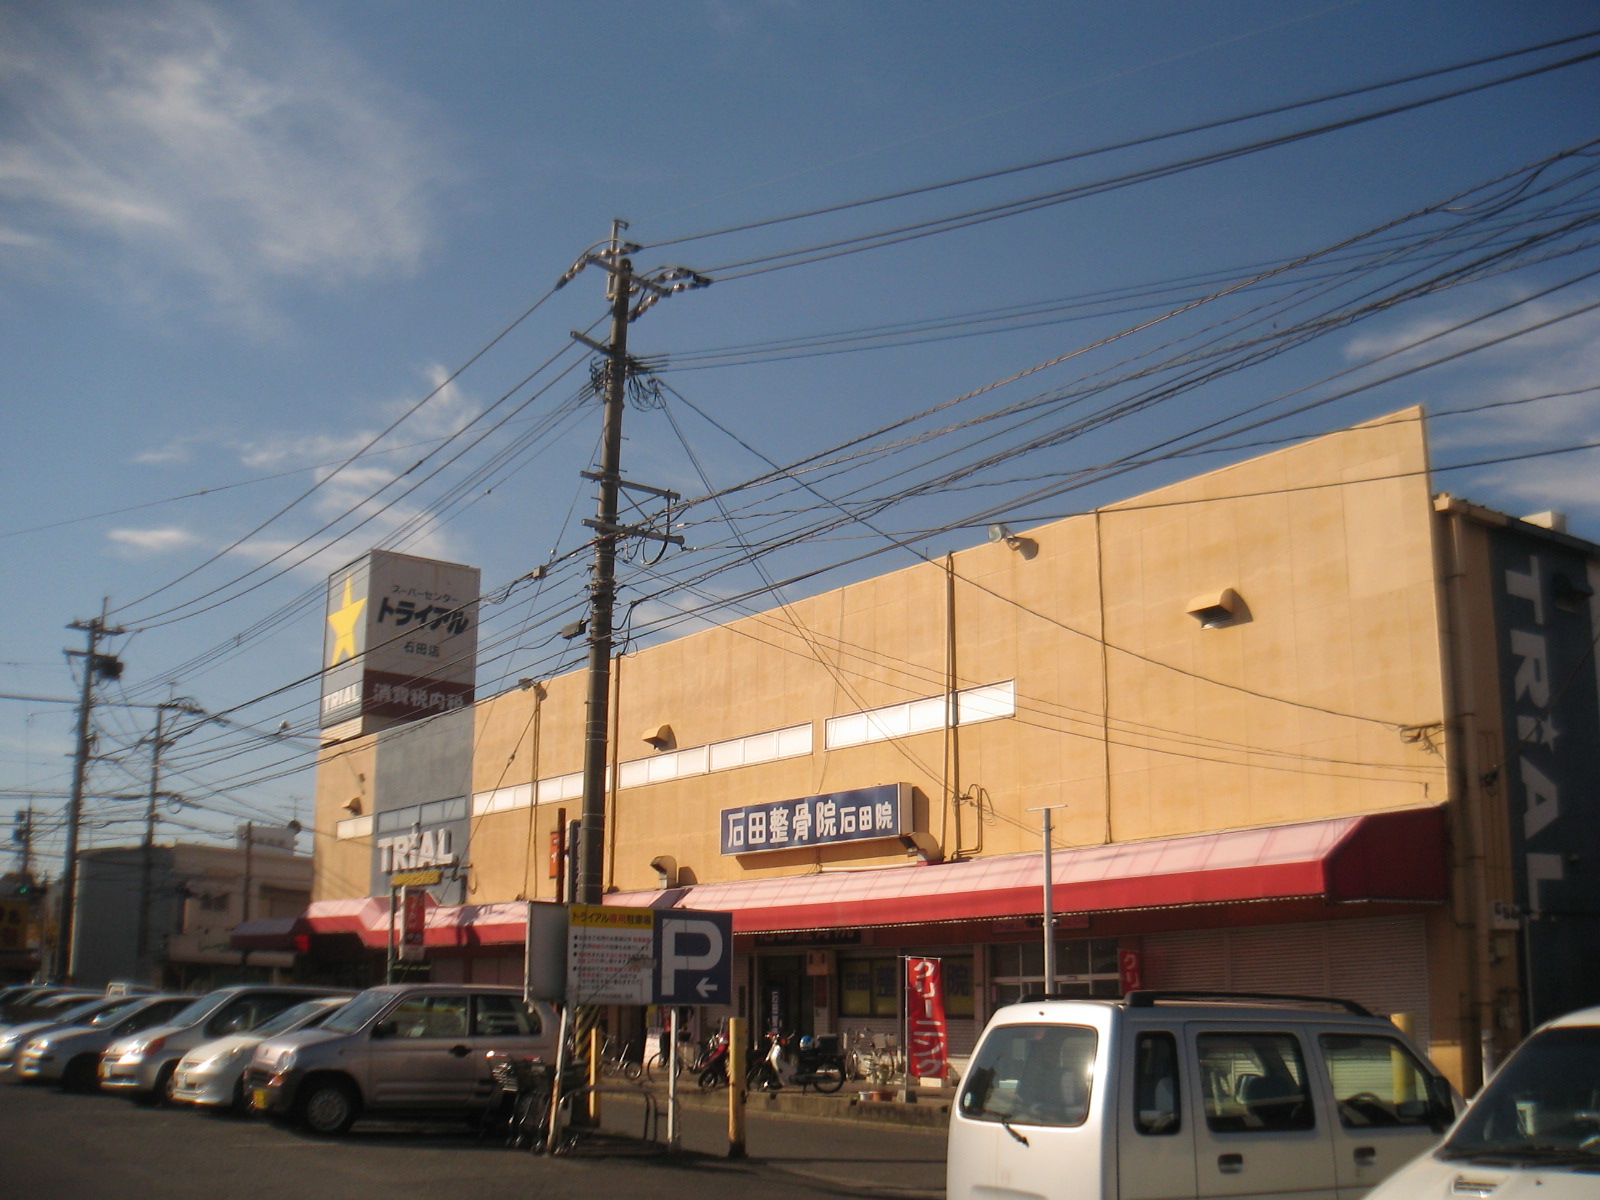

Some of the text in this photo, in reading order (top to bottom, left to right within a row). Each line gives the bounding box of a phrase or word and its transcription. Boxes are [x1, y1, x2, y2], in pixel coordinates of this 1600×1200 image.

[392, 585, 459, 603] スーパーセンター
[377, 597, 470, 635] トライアル
[404, 641, 440, 658] 石田店
[322, 684, 360, 713] TRIAL
[1505, 555, 1563, 920] TRIAL
[378, 827, 454, 872] TRIAL
[661, 919, 723, 996] P
[913, 961, 944, 1076] クリーニング
